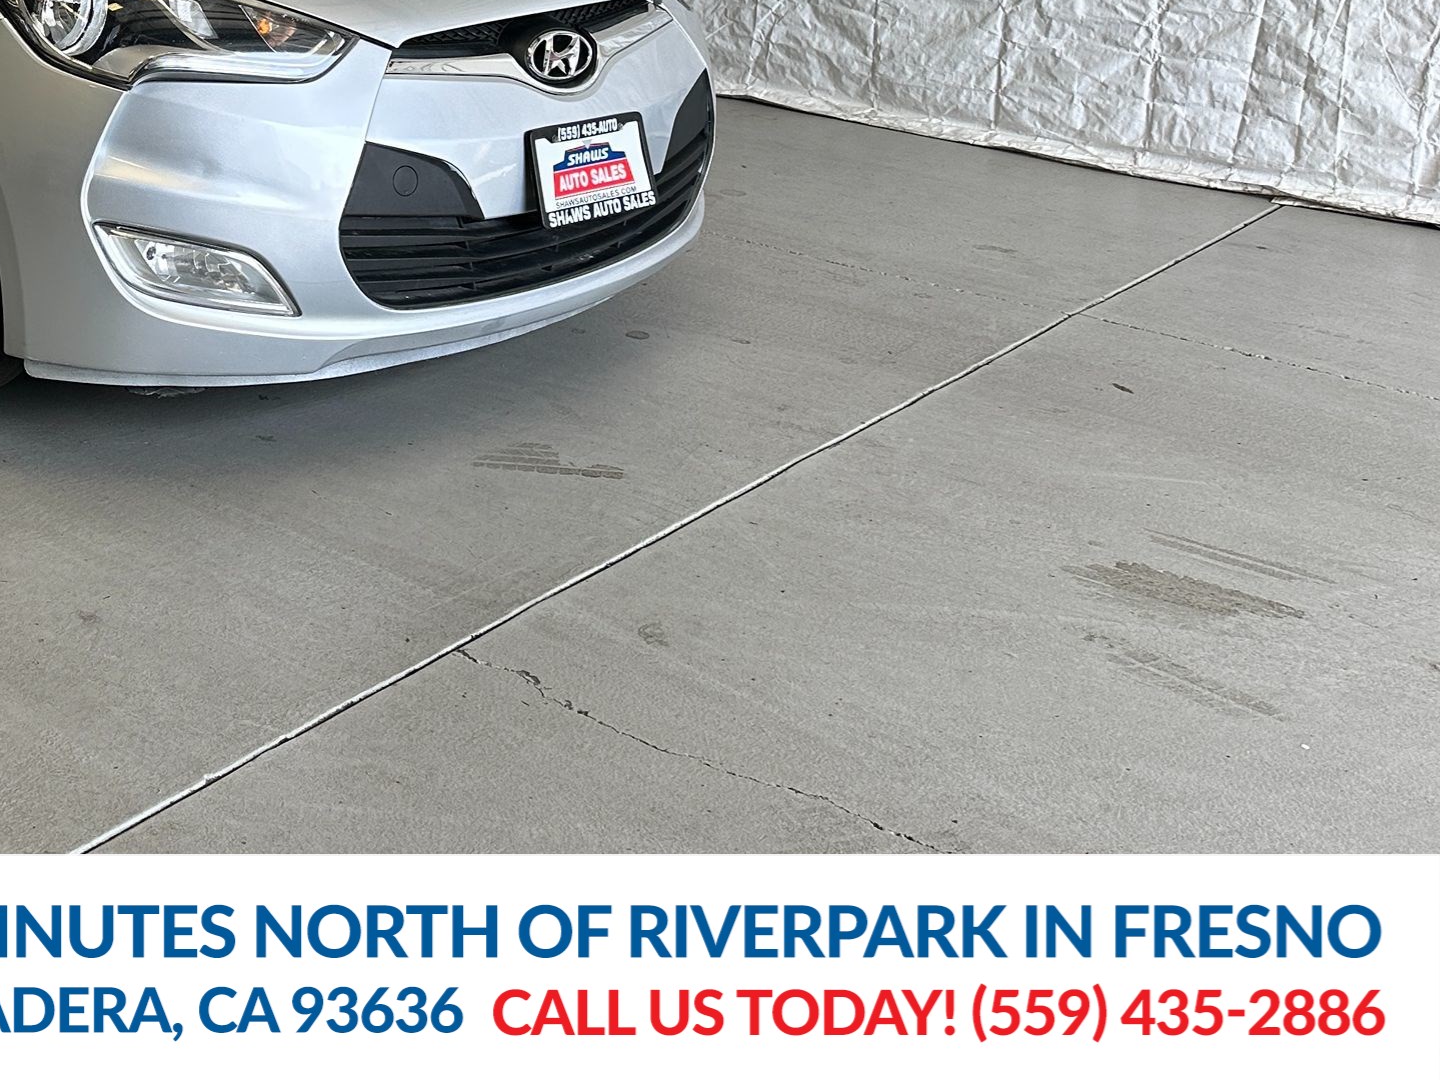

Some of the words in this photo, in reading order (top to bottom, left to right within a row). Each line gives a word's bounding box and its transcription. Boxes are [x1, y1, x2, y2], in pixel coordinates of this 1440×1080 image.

[558, 124, 580, 141] (559)
[582, 118, 618, 136] 435-AUTO
[567, 147, 609, 167] SHAWS
[560, 171, 589, 192] AUTO
[590, 163, 626, 184] SALES
[556, 186, 637, 209] SHAWSAUTOSALES.COM
[548, 204, 592, 228] SHAWS
[594, 199, 621, 218] AUTO
[623, 191, 656, 211] SALES
